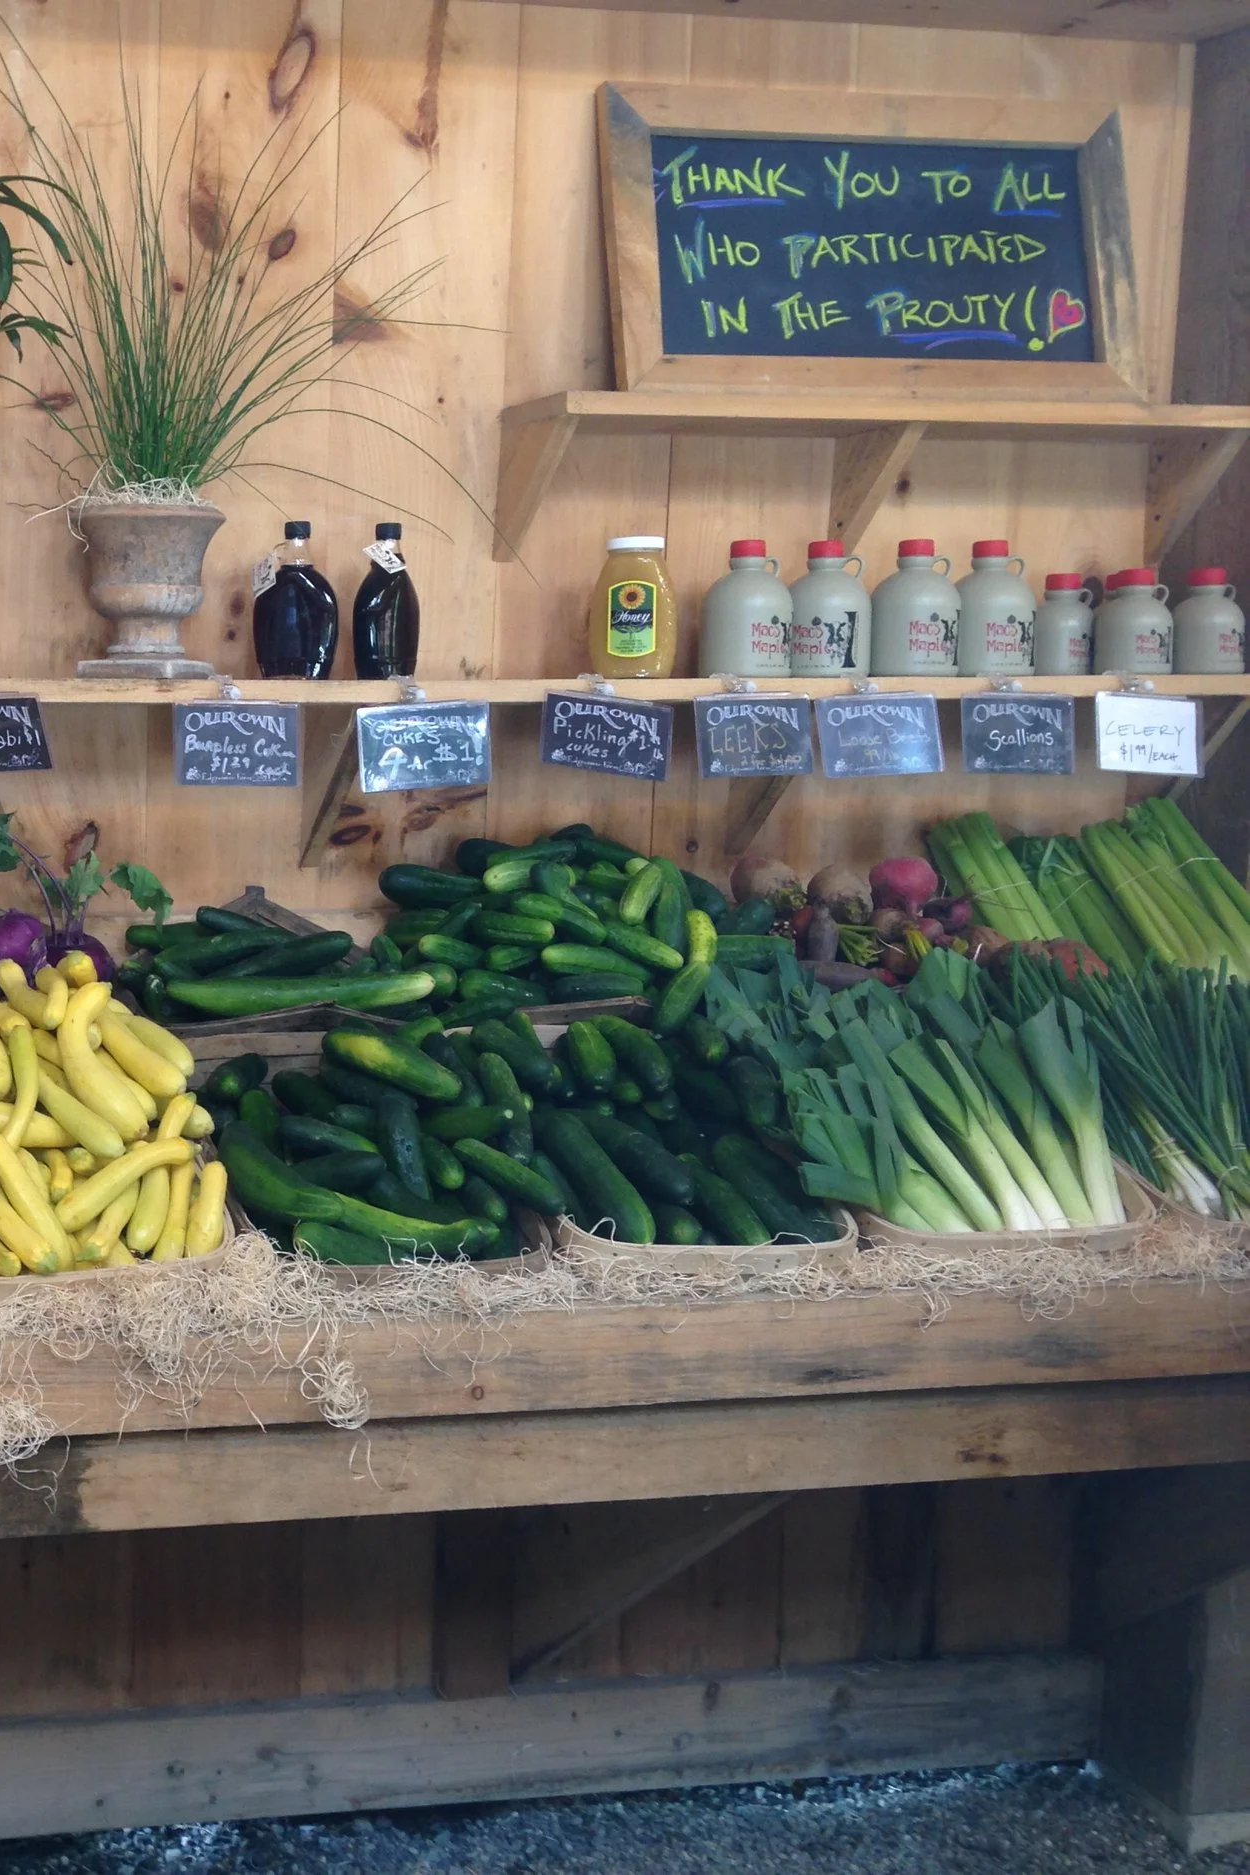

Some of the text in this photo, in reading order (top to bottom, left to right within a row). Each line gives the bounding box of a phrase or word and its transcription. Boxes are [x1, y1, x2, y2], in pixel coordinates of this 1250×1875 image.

[661, 146, 1066, 213] THANK YOU TO ALL
[674, 216, 1046, 284] WHO PARTICIPATED
[700, 286, 1044, 351] IN THE PROUTY!
[612, 610, 652, 625] Honey
[383, 729, 443, 746] CUKES
[553, 716, 631, 757] Pickling
[707, 722, 787, 755] LEEKS
[838, 729, 883, 747] Loose
[984, 728, 1054, 752] Scallions
[1105, 721, 1185, 747] CELERY
[378, 747, 408, 780] 4
